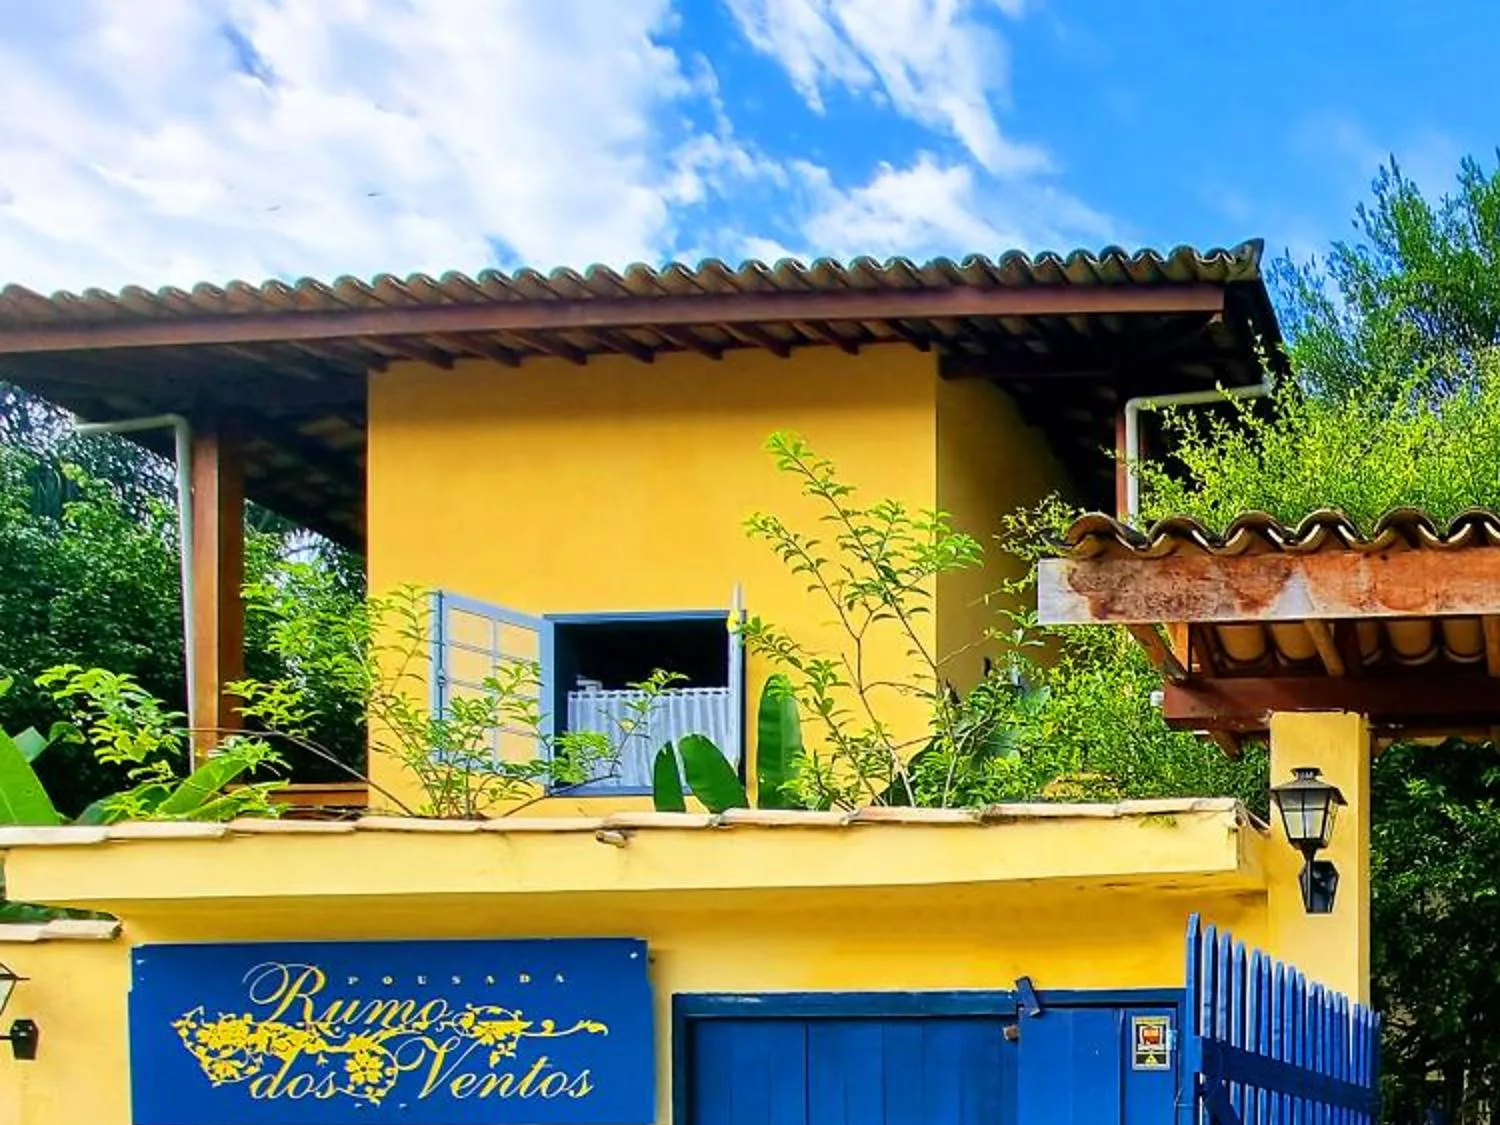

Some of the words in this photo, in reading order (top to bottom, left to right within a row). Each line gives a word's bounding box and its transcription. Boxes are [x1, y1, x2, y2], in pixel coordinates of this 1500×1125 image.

[242, 961, 450, 1030] Rumo
[347, 973, 565, 986] POUSADA
[250, 1045, 338, 1099] dos
[393, 1035, 594, 1100] Ventos
